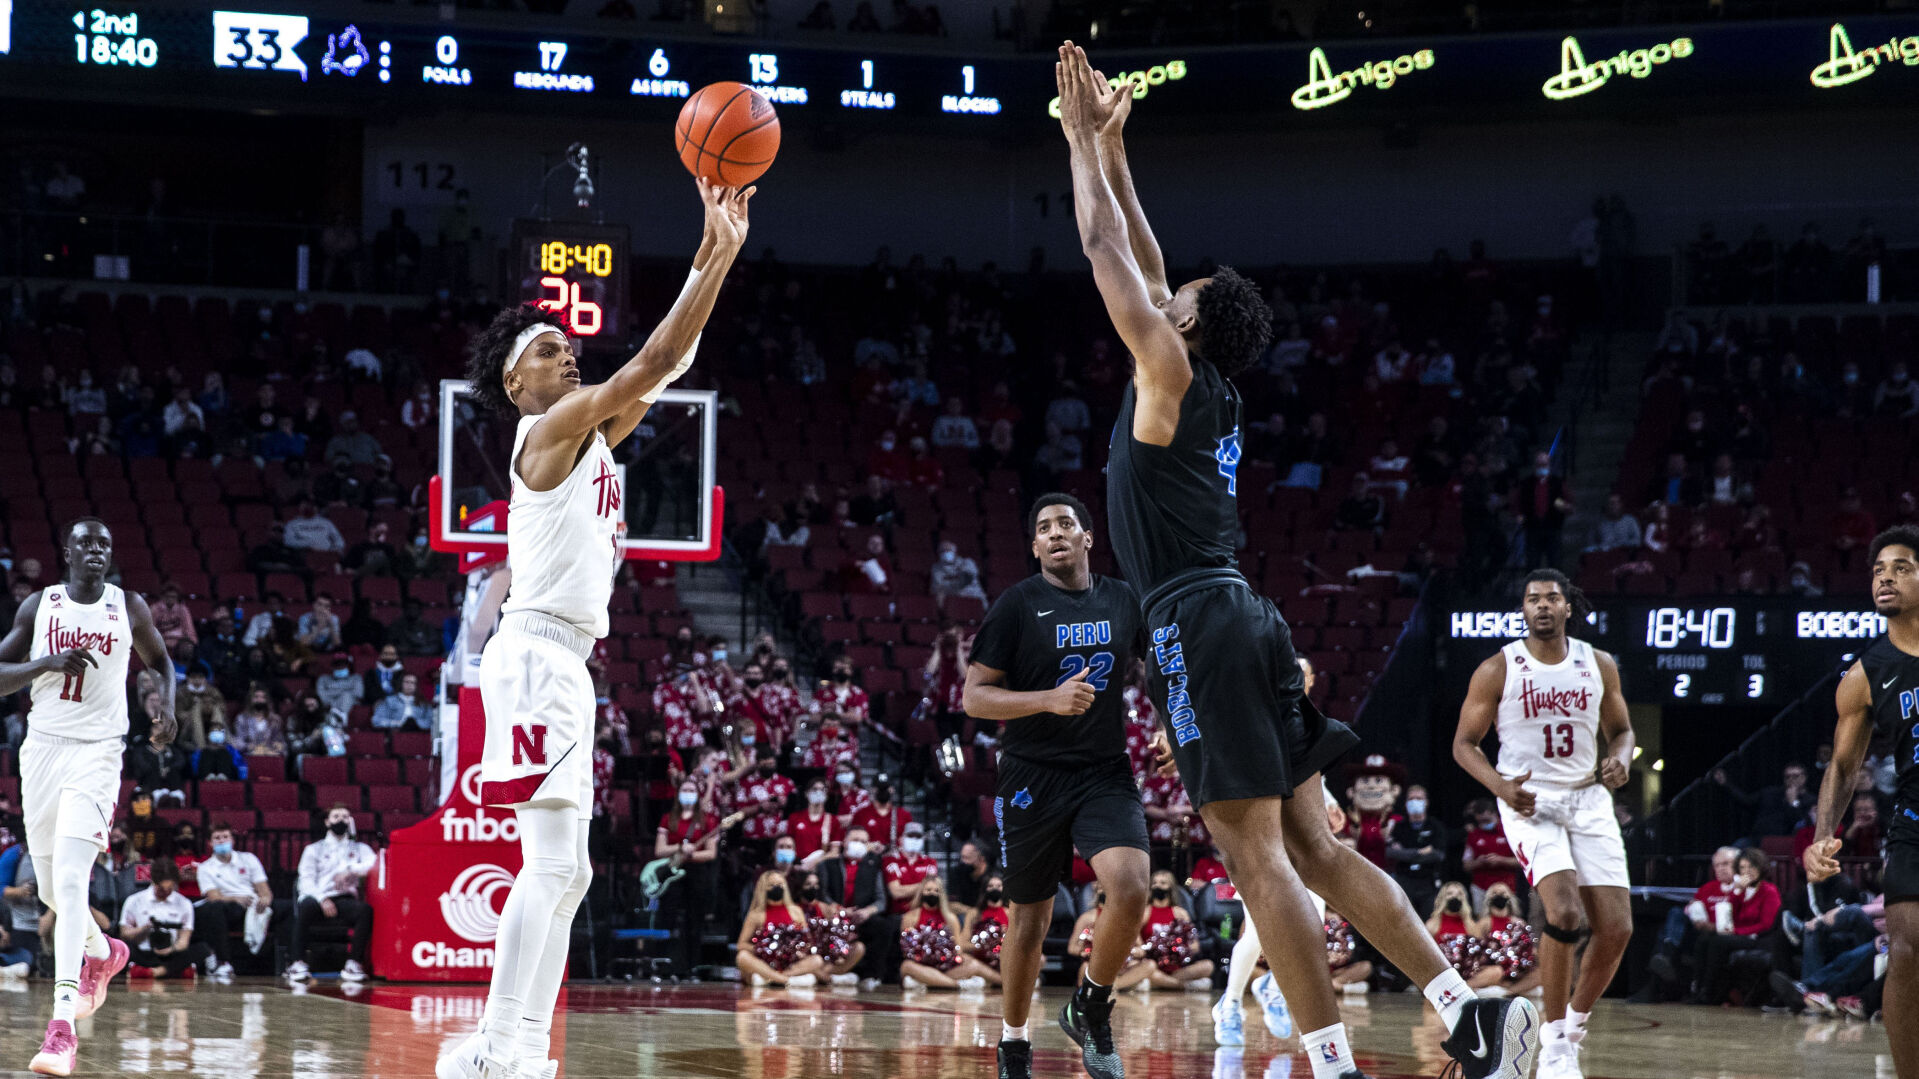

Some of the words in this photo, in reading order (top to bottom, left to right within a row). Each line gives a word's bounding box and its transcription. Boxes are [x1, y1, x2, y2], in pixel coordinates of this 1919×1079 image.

[91, 9, 138, 35] 2nd
[75, 34, 158, 67] 18:40
[228, 27, 283, 67] 33
[436, 36, 458, 65] 0
[539, 42, 568, 71] 17
[423, 65, 473, 85] FOULS
[649, 48, 670, 77] 6
[749, 54, 779, 83] 13
[861, 60, 874, 89] 1
[1542, 36, 1694, 100] Amigos
[514, 71, 595, 92] REBOUNDS
[630, 78, 690, 97] ASSISTS
[962, 66, 975, 94] 1
[1291, 47, 1435, 110] Amigos
[841, 90, 895, 109] STEALS
[942, 95, 1001, 115] BLOCKS
[387, 161, 457, 190] 112
[541, 241, 612, 277] 18:40
[44, 615, 118, 656] Huskers
[1056, 620, 1111, 648] PERU
[1646, 607, 1736, 649] 18:40
[1056, 651, 1115, 691] 22
[1657, 654, 1708, 670] PERIOD
[60, 667, 86, 703] 11
[1153, 623, 1201, 747] BOBCATS
[1518, 678, 1592, 719] Huskers
[1673, 673, 1691, 698] 2
[1747, 673, 1764, 698] 3
[512, 723, 548, 767] N
[1542, 723, 1574, 759] 13
[440, 808, 520, 842] fnbo
[411, 941, 496, 968] Chan
